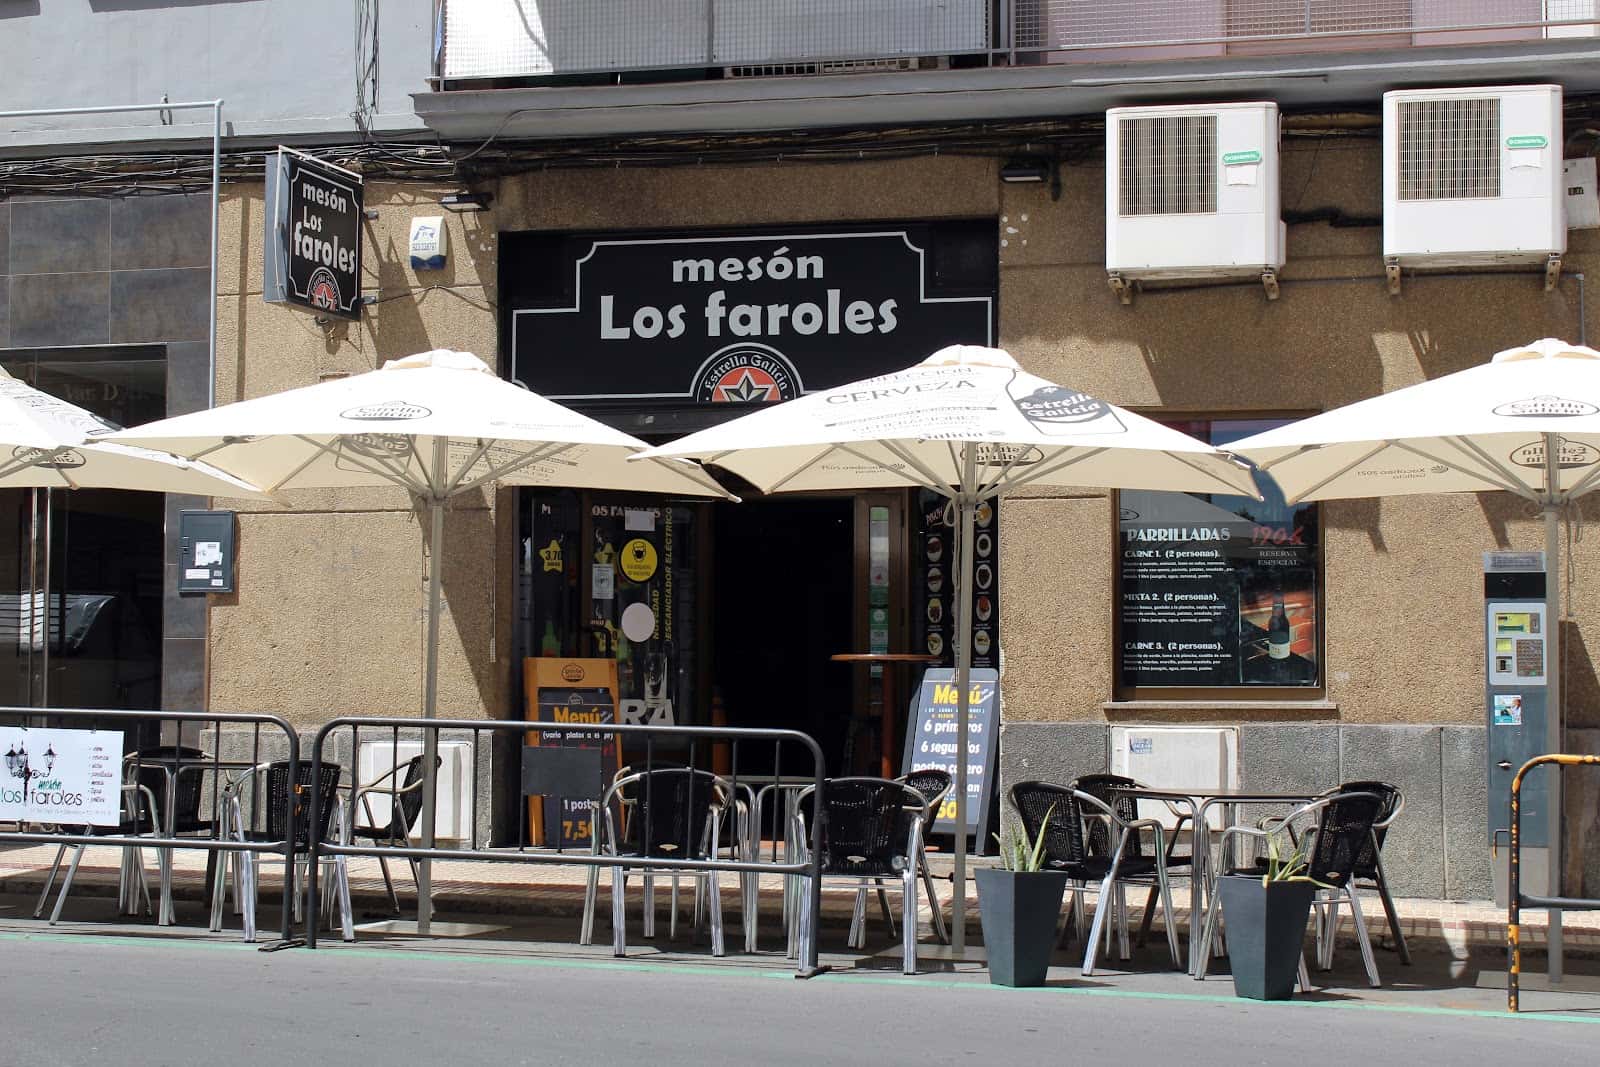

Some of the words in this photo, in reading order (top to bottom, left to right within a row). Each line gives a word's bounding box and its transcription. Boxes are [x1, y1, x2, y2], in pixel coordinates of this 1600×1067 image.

[302, 183, 347, 214] mesón
[303, 205, 323, 233] Los
[294, 221, 356, 275] faroles
[673, 246, 824, 283] mesón
[600, 294, 686, 340] Los
[705, 287, 898, 338] faroles
[705, 355, 747, 391] Estrella
[751, 354, 788, 391] Galicia
[826, 380, 976, 405] CERVEZA
[1027, 402, 1101, 417] Galicia
[663, 507, 673, 562] ELECTRICO
[1127, 527, 1231, 542] PARRILLADAS
[1125, 550, 1154, 558] CARNE
[663, 566, 673, 642] ESCANCIADOR
[1125, 642, 1154, 650] CARNE
[933, 684, 981, 705] Meú
[554, 706, 599, 724] Menú
[924, 720, 932, 732] 6
[934, 720, 983, 735] primros
[921, 741, 928, 753] 6
[948, 764, 983, 774] caero
[1, 787, 21, 804] los
